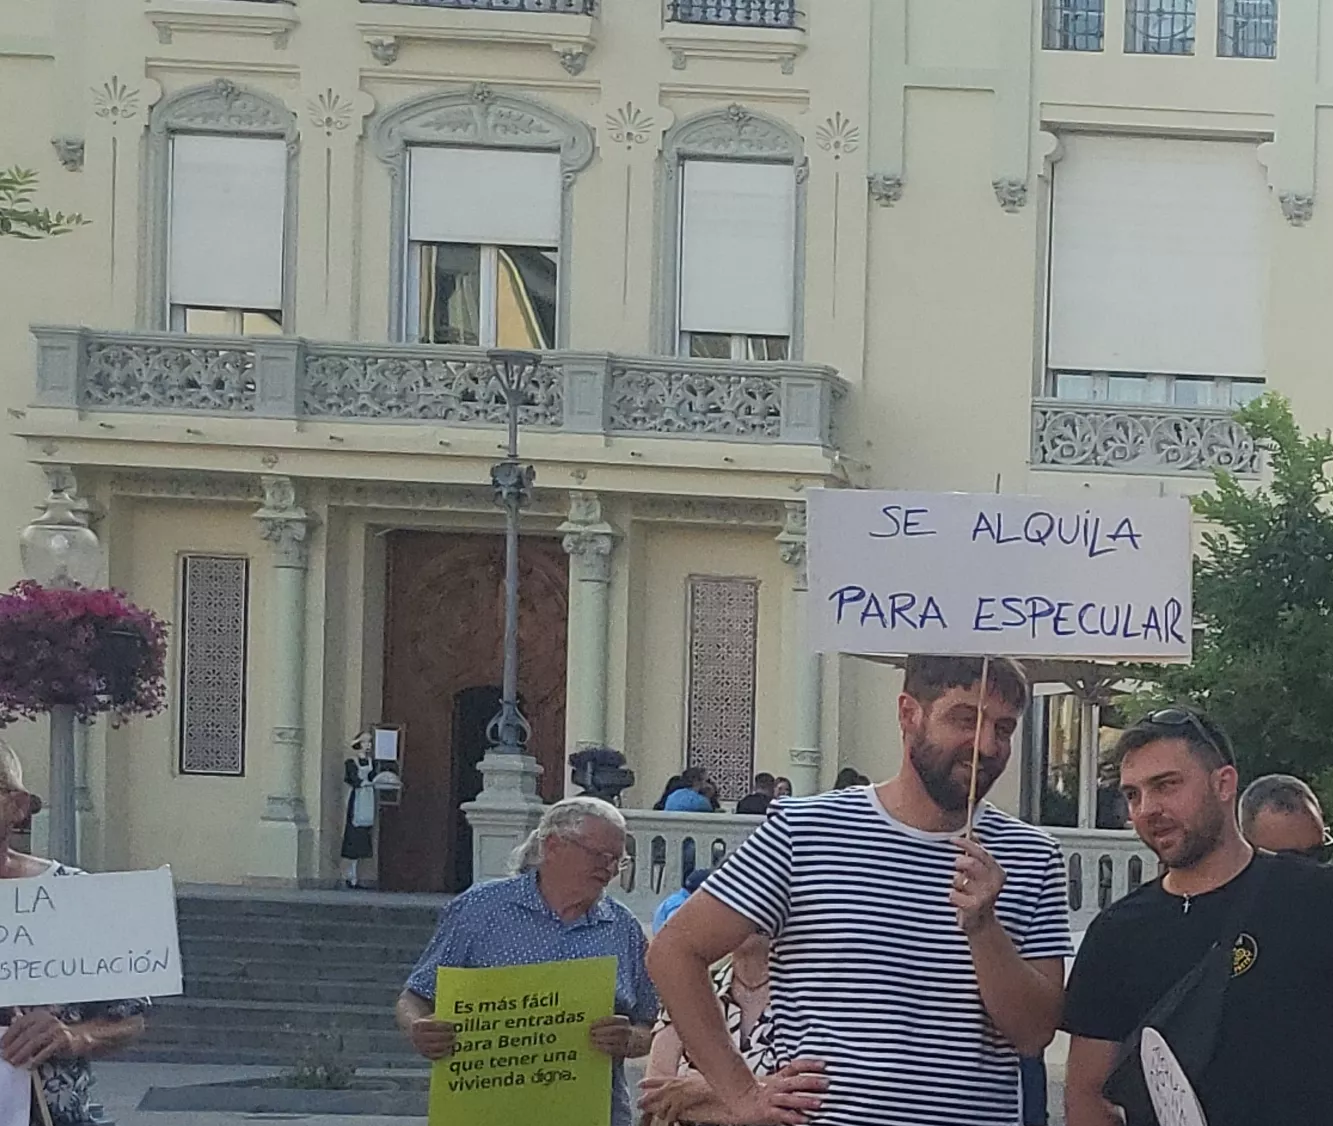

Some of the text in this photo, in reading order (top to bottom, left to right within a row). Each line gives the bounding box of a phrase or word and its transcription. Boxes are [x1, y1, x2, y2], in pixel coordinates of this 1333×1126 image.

[869, 505, 937, 538] SE
[829, 585, 1186, 644] PARA ESPECULAR
[15, 886, 56, 914] LA
[454, 992, 559, 1014] Es más fácil
[505, 1010, 586, 1029] entradas
[451, 1031, 557, 1057] para Benito
[450, 1050, 577, 1076] que tener una
[448, 1072, 525, 1092] vivienda
